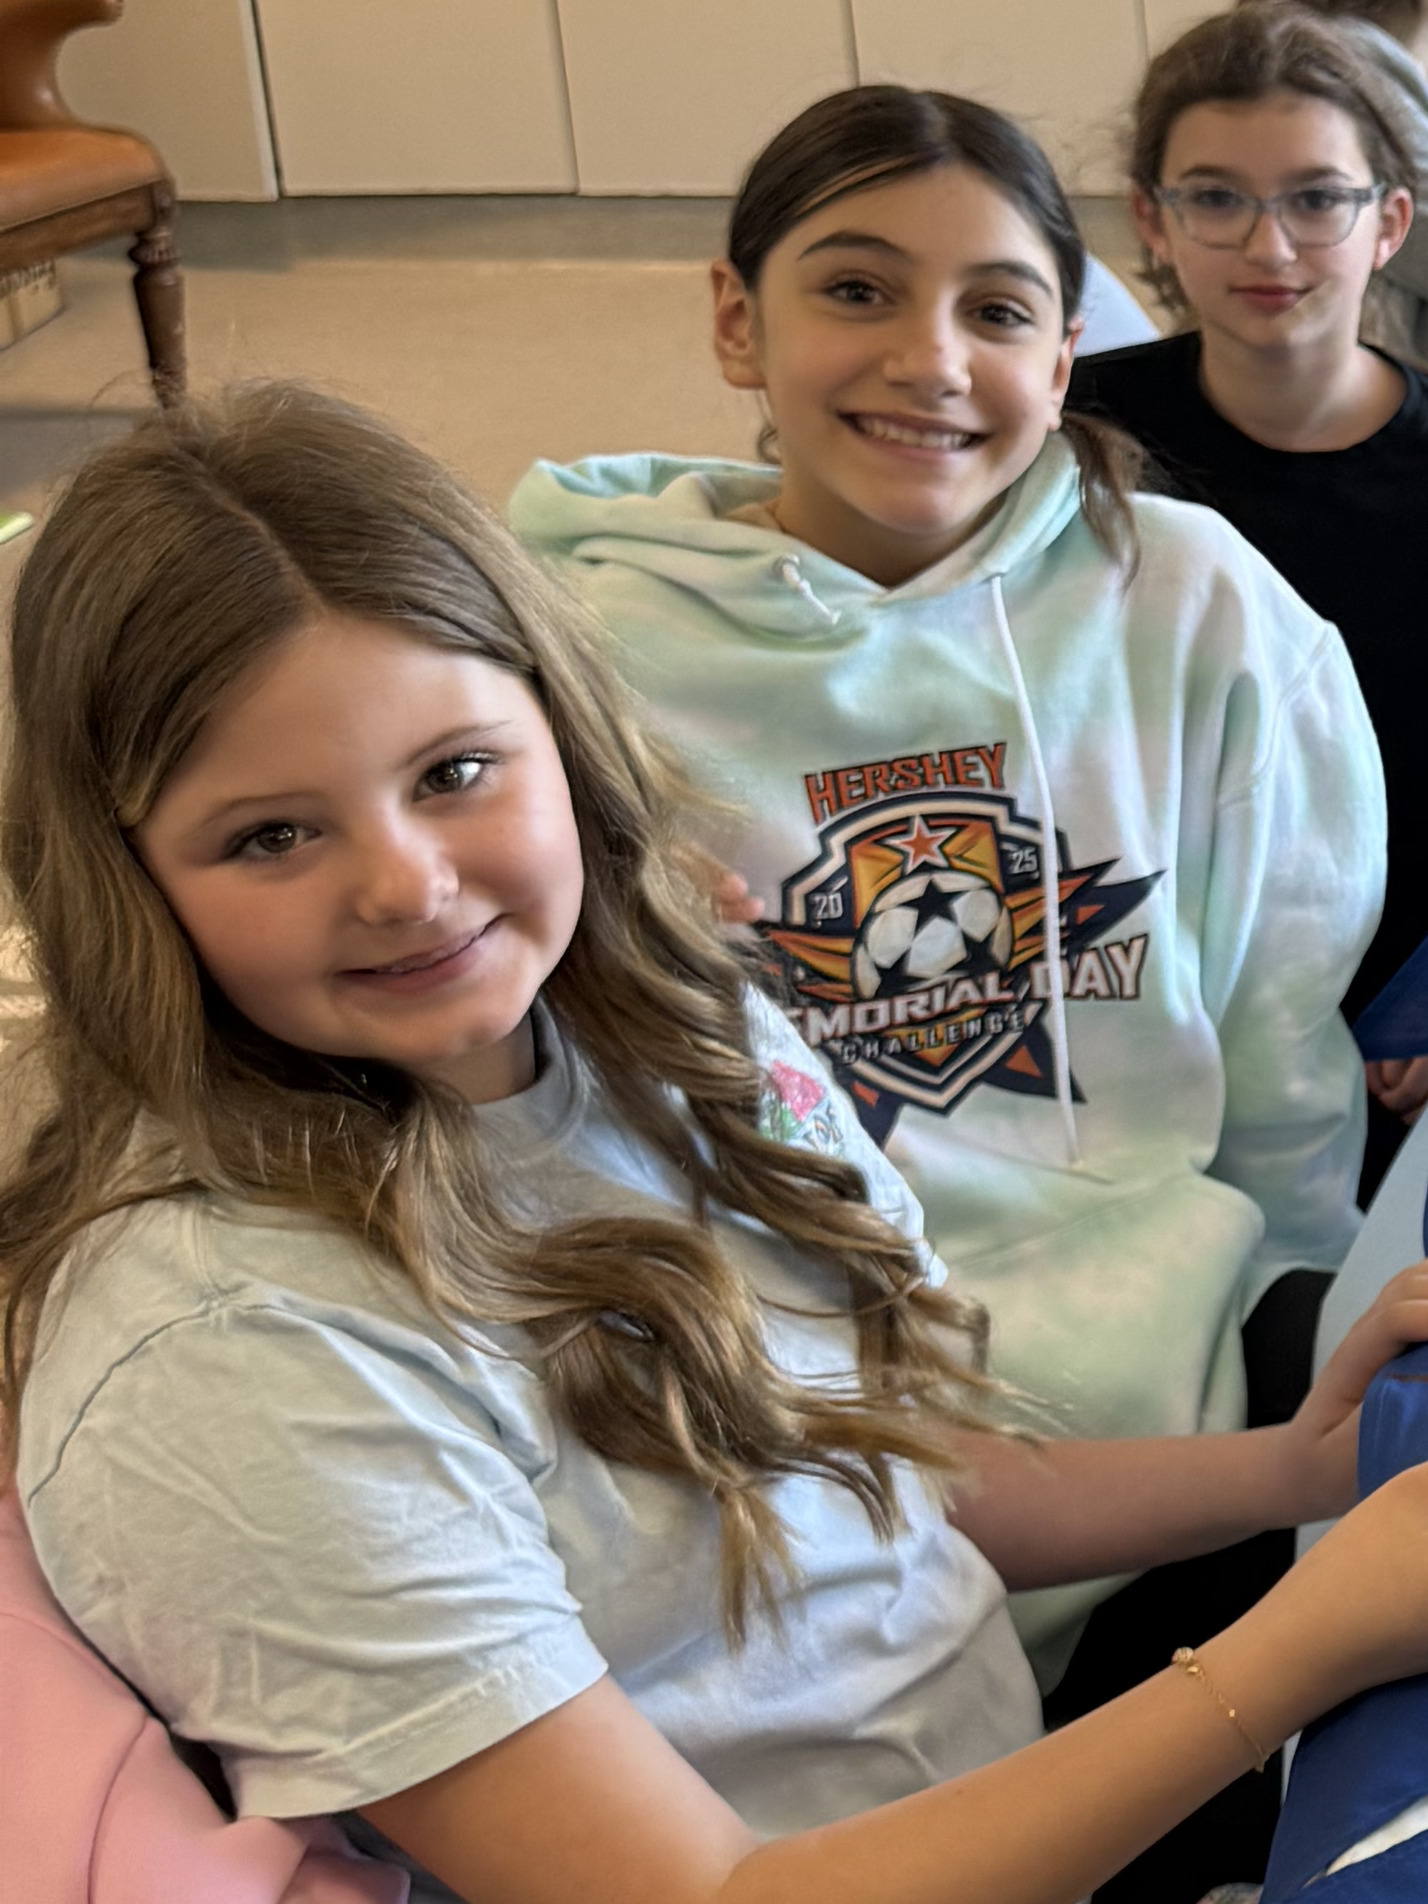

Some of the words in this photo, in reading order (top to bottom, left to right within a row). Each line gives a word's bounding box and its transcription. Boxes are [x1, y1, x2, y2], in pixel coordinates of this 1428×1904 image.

[804, 742, 1008, 825] HERSHEY
[1011, 848, 1039, 874] 25
[812, 892, 843, 920] 20
[790, 972, 1015, 1046] MORIAL
[1029, 934, 1149, 1002] DAY
[842, 1006, 1025, 1064] CHALLENGE
